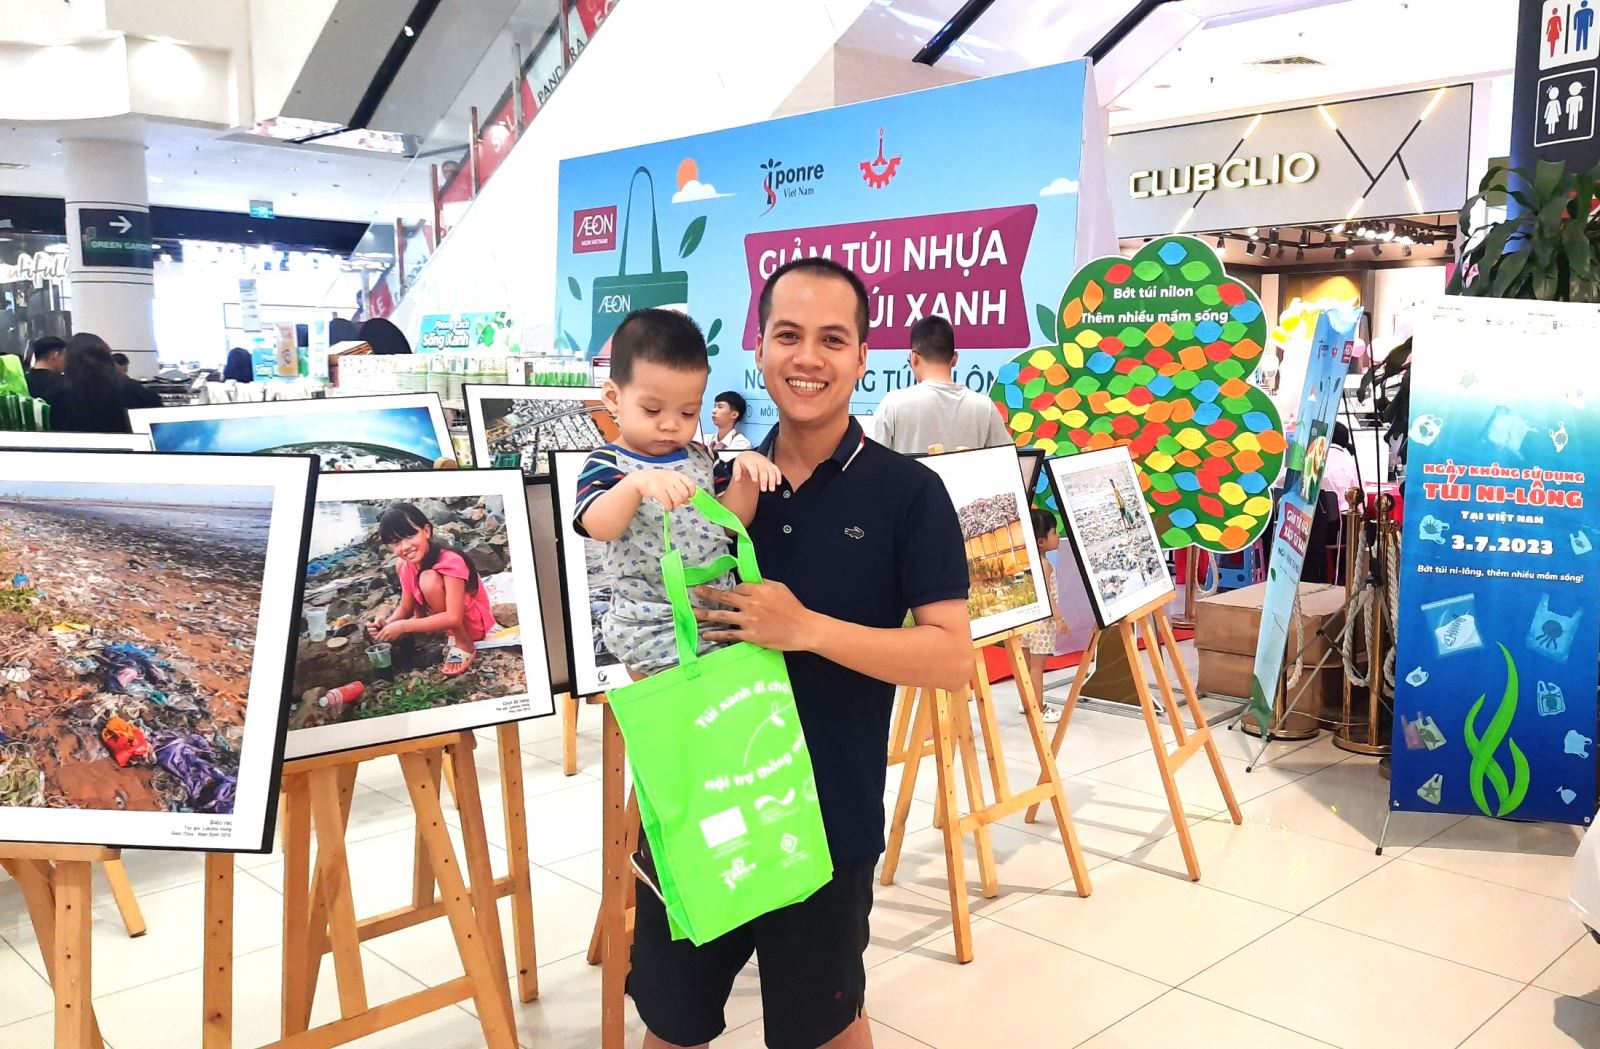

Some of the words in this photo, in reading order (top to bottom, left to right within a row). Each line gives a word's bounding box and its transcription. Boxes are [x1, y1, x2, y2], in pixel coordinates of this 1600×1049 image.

[537, 37, 586, 107] PANDRA
[798, 186, 815, 197] Nam
[91, 240, 122, 249] GREEN
[841, 231, 891, 274] TÚI
[902, 226, 1008, 278] NHỰA
[1113, 287, 1136, 299] Bớt
[1139, 285, 1157, 298] túi
[1160, 285, 1194, 298] nilon
[867, 286, 894, 328] ÚI
[904, 289, 1006, 329] XANH
[1082, 309, 1114, 323] Thêm
[1119, 308, 1154, 323] nhiều
[1157, 309, 1191, 321] mầm
[1195, 308, 1229, 324] sống
[1423, 459, 1467, 476] NGÀY
[1469, 462, 1521, 479] KHÔNG
[1543, 471, 1585, 485] DỤNG
[1423, 474, 1471, 502] TÚI
[1477, 480, 1584, 509] NI-LÔNG
[1461, 511, 1484, 523] TẠI
[1486, 511, 1515, 525] VIỆT
[1516, 515, 1544, 525] NAM
[1452, 535, 1553, 555] 3.7.2023
[1417, 564, 1433, 574] Bớt
[1435, 564, 1448, 574] túi
[1450, 565, 1484, 578] ni-lông,
[1487, 568, 1511, 578] thêm
[1561, 572, 1584, 584] sống!
[695, 706, 720, 728] Túi
[719, 687, 751, 712] xanh
[704, 774, 730, 792] nội
